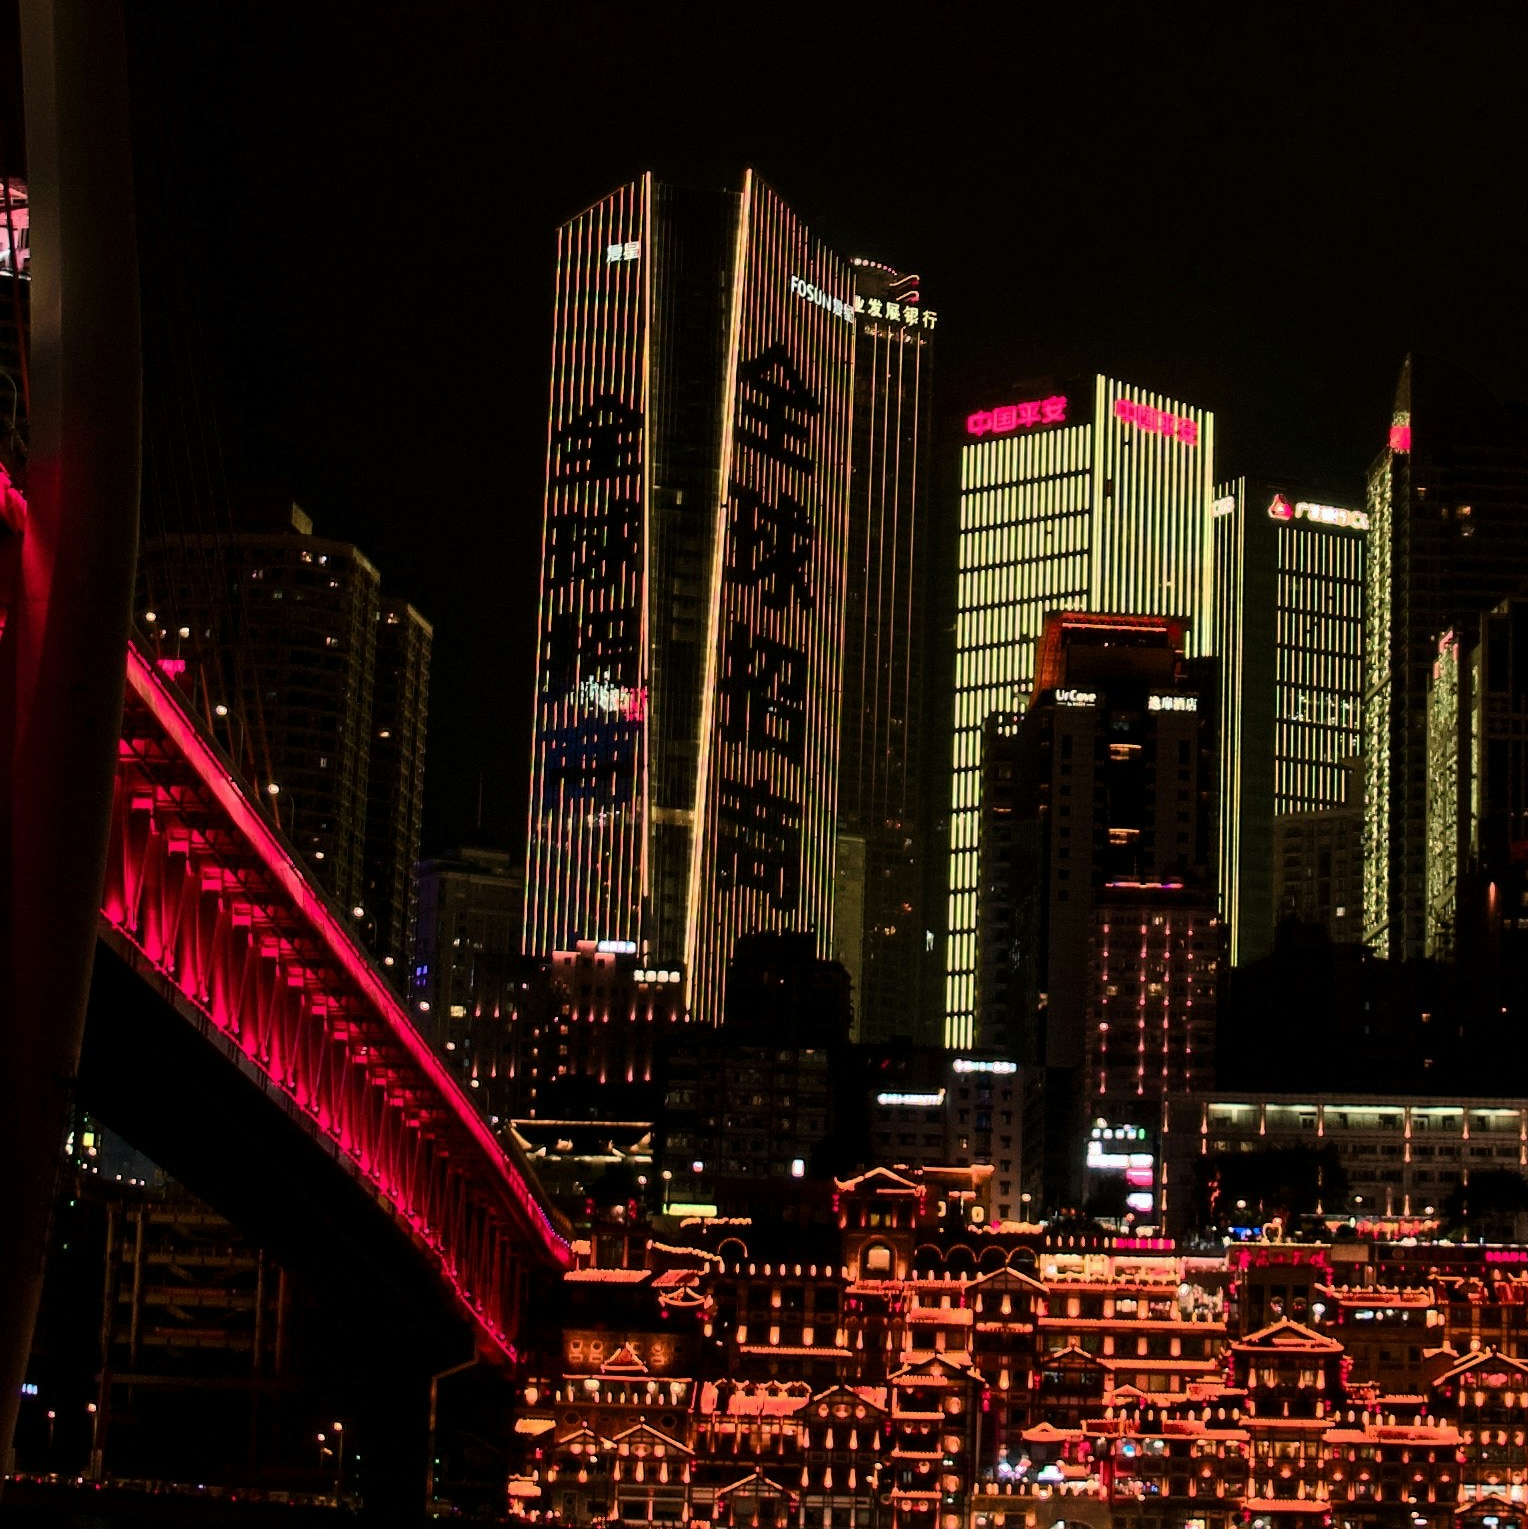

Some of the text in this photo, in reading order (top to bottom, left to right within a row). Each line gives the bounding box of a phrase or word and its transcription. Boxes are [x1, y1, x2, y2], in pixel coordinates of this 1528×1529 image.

[790, 275, 832, 312] FOSUN
[967, 396, 1068, 437] 中国平安
[1115, 398, 1199, 446] 中国平安
[716, 340, 824, 912] 全球招商
[1055, 689, 1097, 703] UrCove
